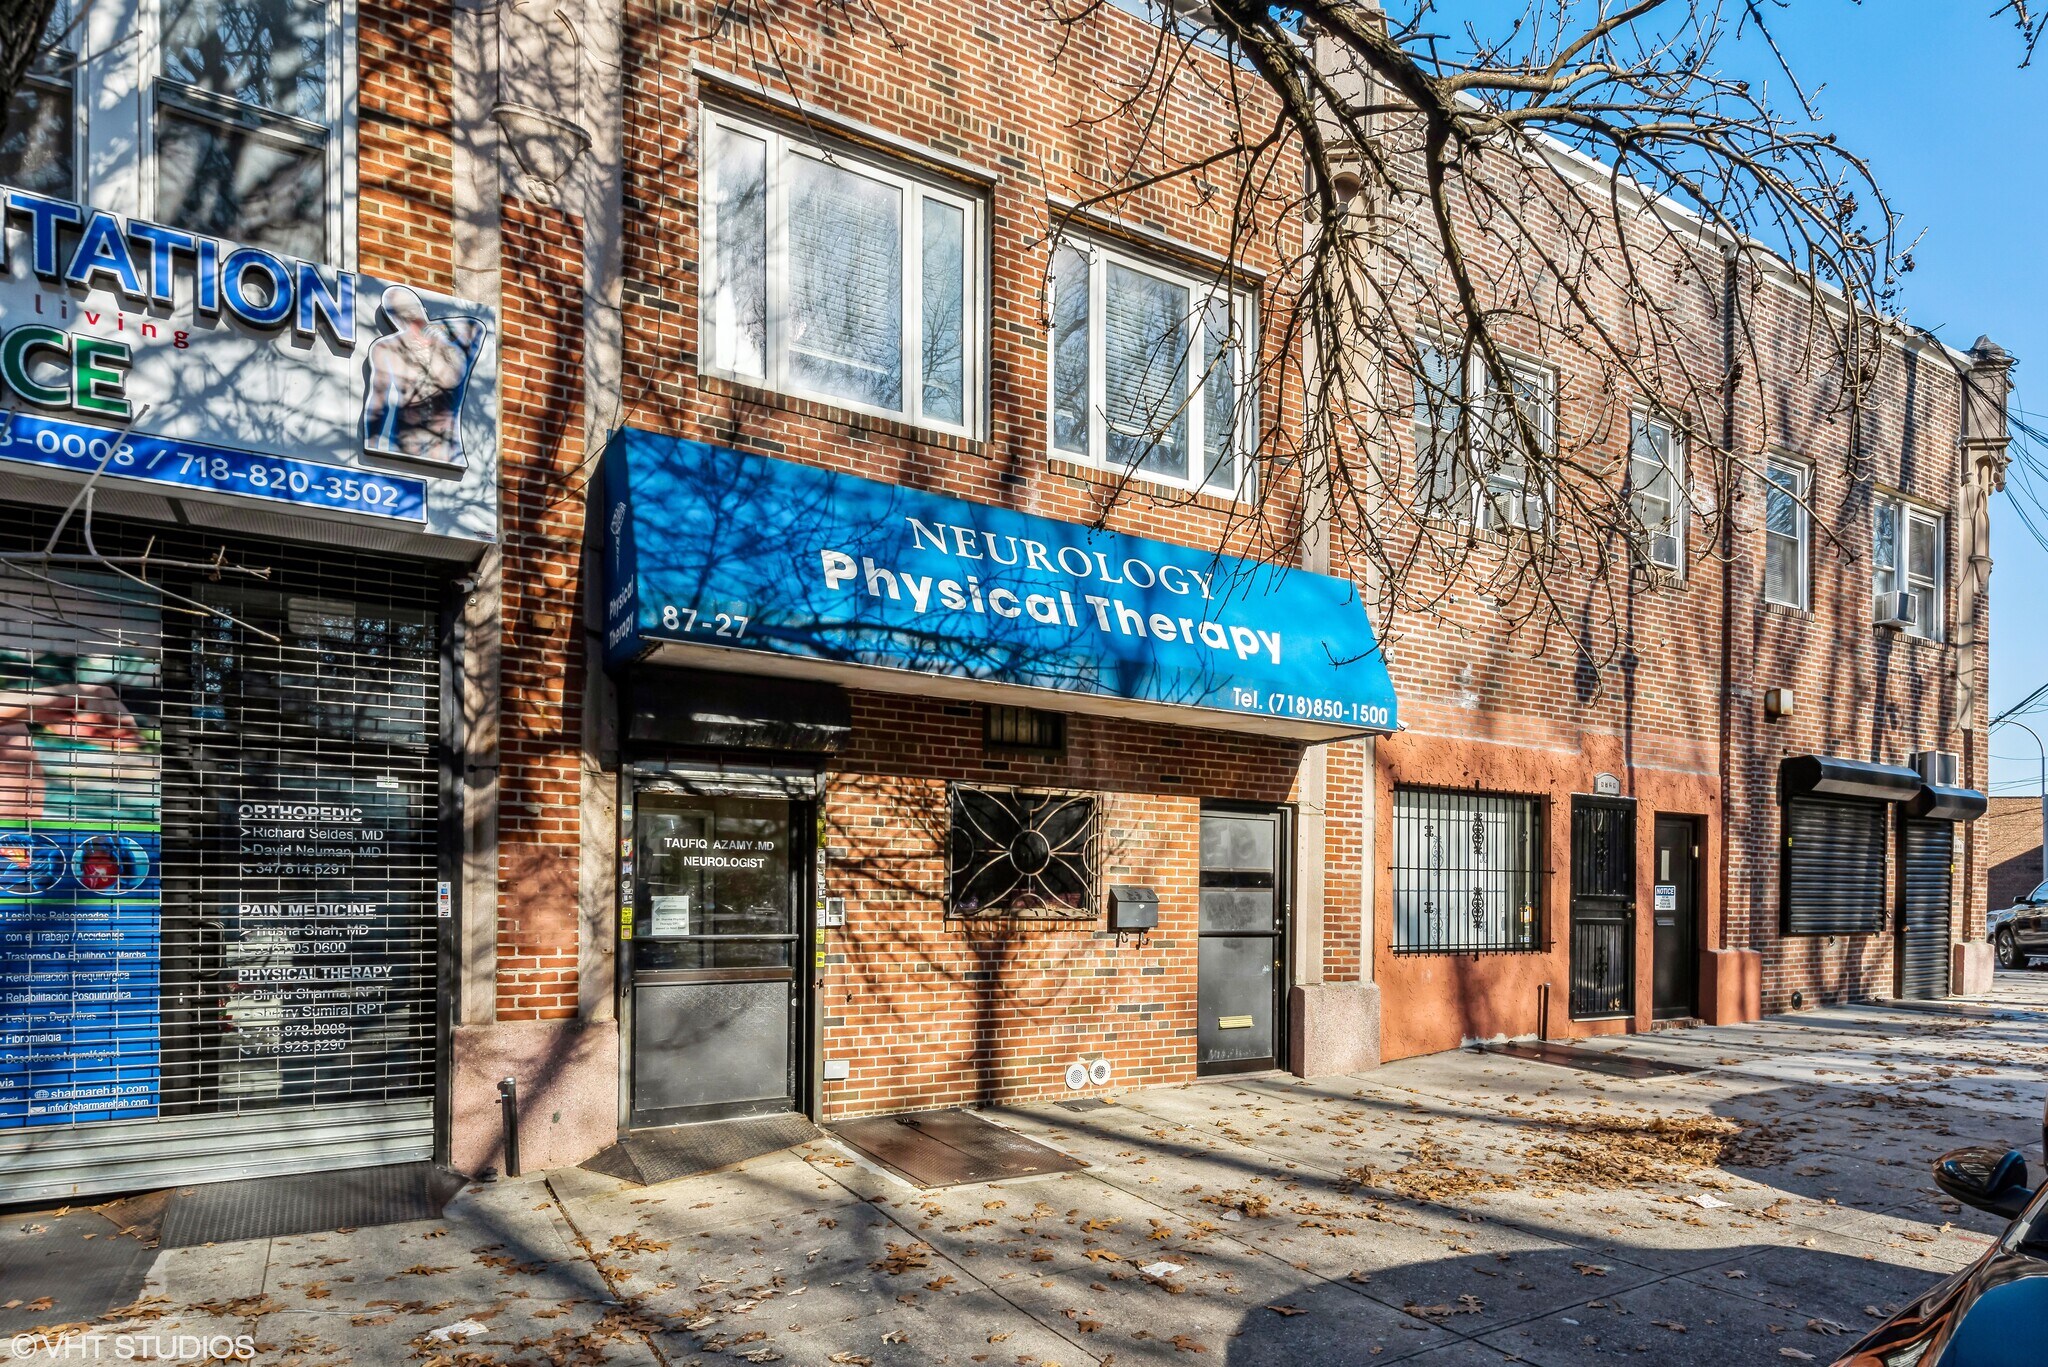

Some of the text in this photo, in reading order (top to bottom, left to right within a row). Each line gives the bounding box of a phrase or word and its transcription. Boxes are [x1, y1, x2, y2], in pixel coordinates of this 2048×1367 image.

[0, 189, 357, 346] TATION
[35, 294, 190, 349] living
[177, 452, 399, 508] 718-820-3502
[905, 517, 1214, 600] NEUROLOGY
[609, 574, 634, 621] Physical
[820, 549, 1282, 665] Physical Therapy
[609, 611, 634, 650] Therapy
[662, 605, 749, 639] 87-27
[1233, 687, 1389, 727] Tel. (718)850-1500
[238, 804, 363, 823] ORTHOPEDIC
[253, 827, 305, 839] Richard
[361, 830, 384, 841] MD
[664, 837, 708, 849] TAUFIQ
[253, 844, 292, 856] David
[359, 846, 381, 858] MD
[684, 857, 764, 868] NEUROLOGIST
[239, 904, 376, 917] PAIN MEDICINE
[6, 932, 22, 941] con
[347, 924, 369, 936] MD
[238, 965, 393, 981] PHYSICAL THERAPY
[356, 1003, 385, 1015] RPT
